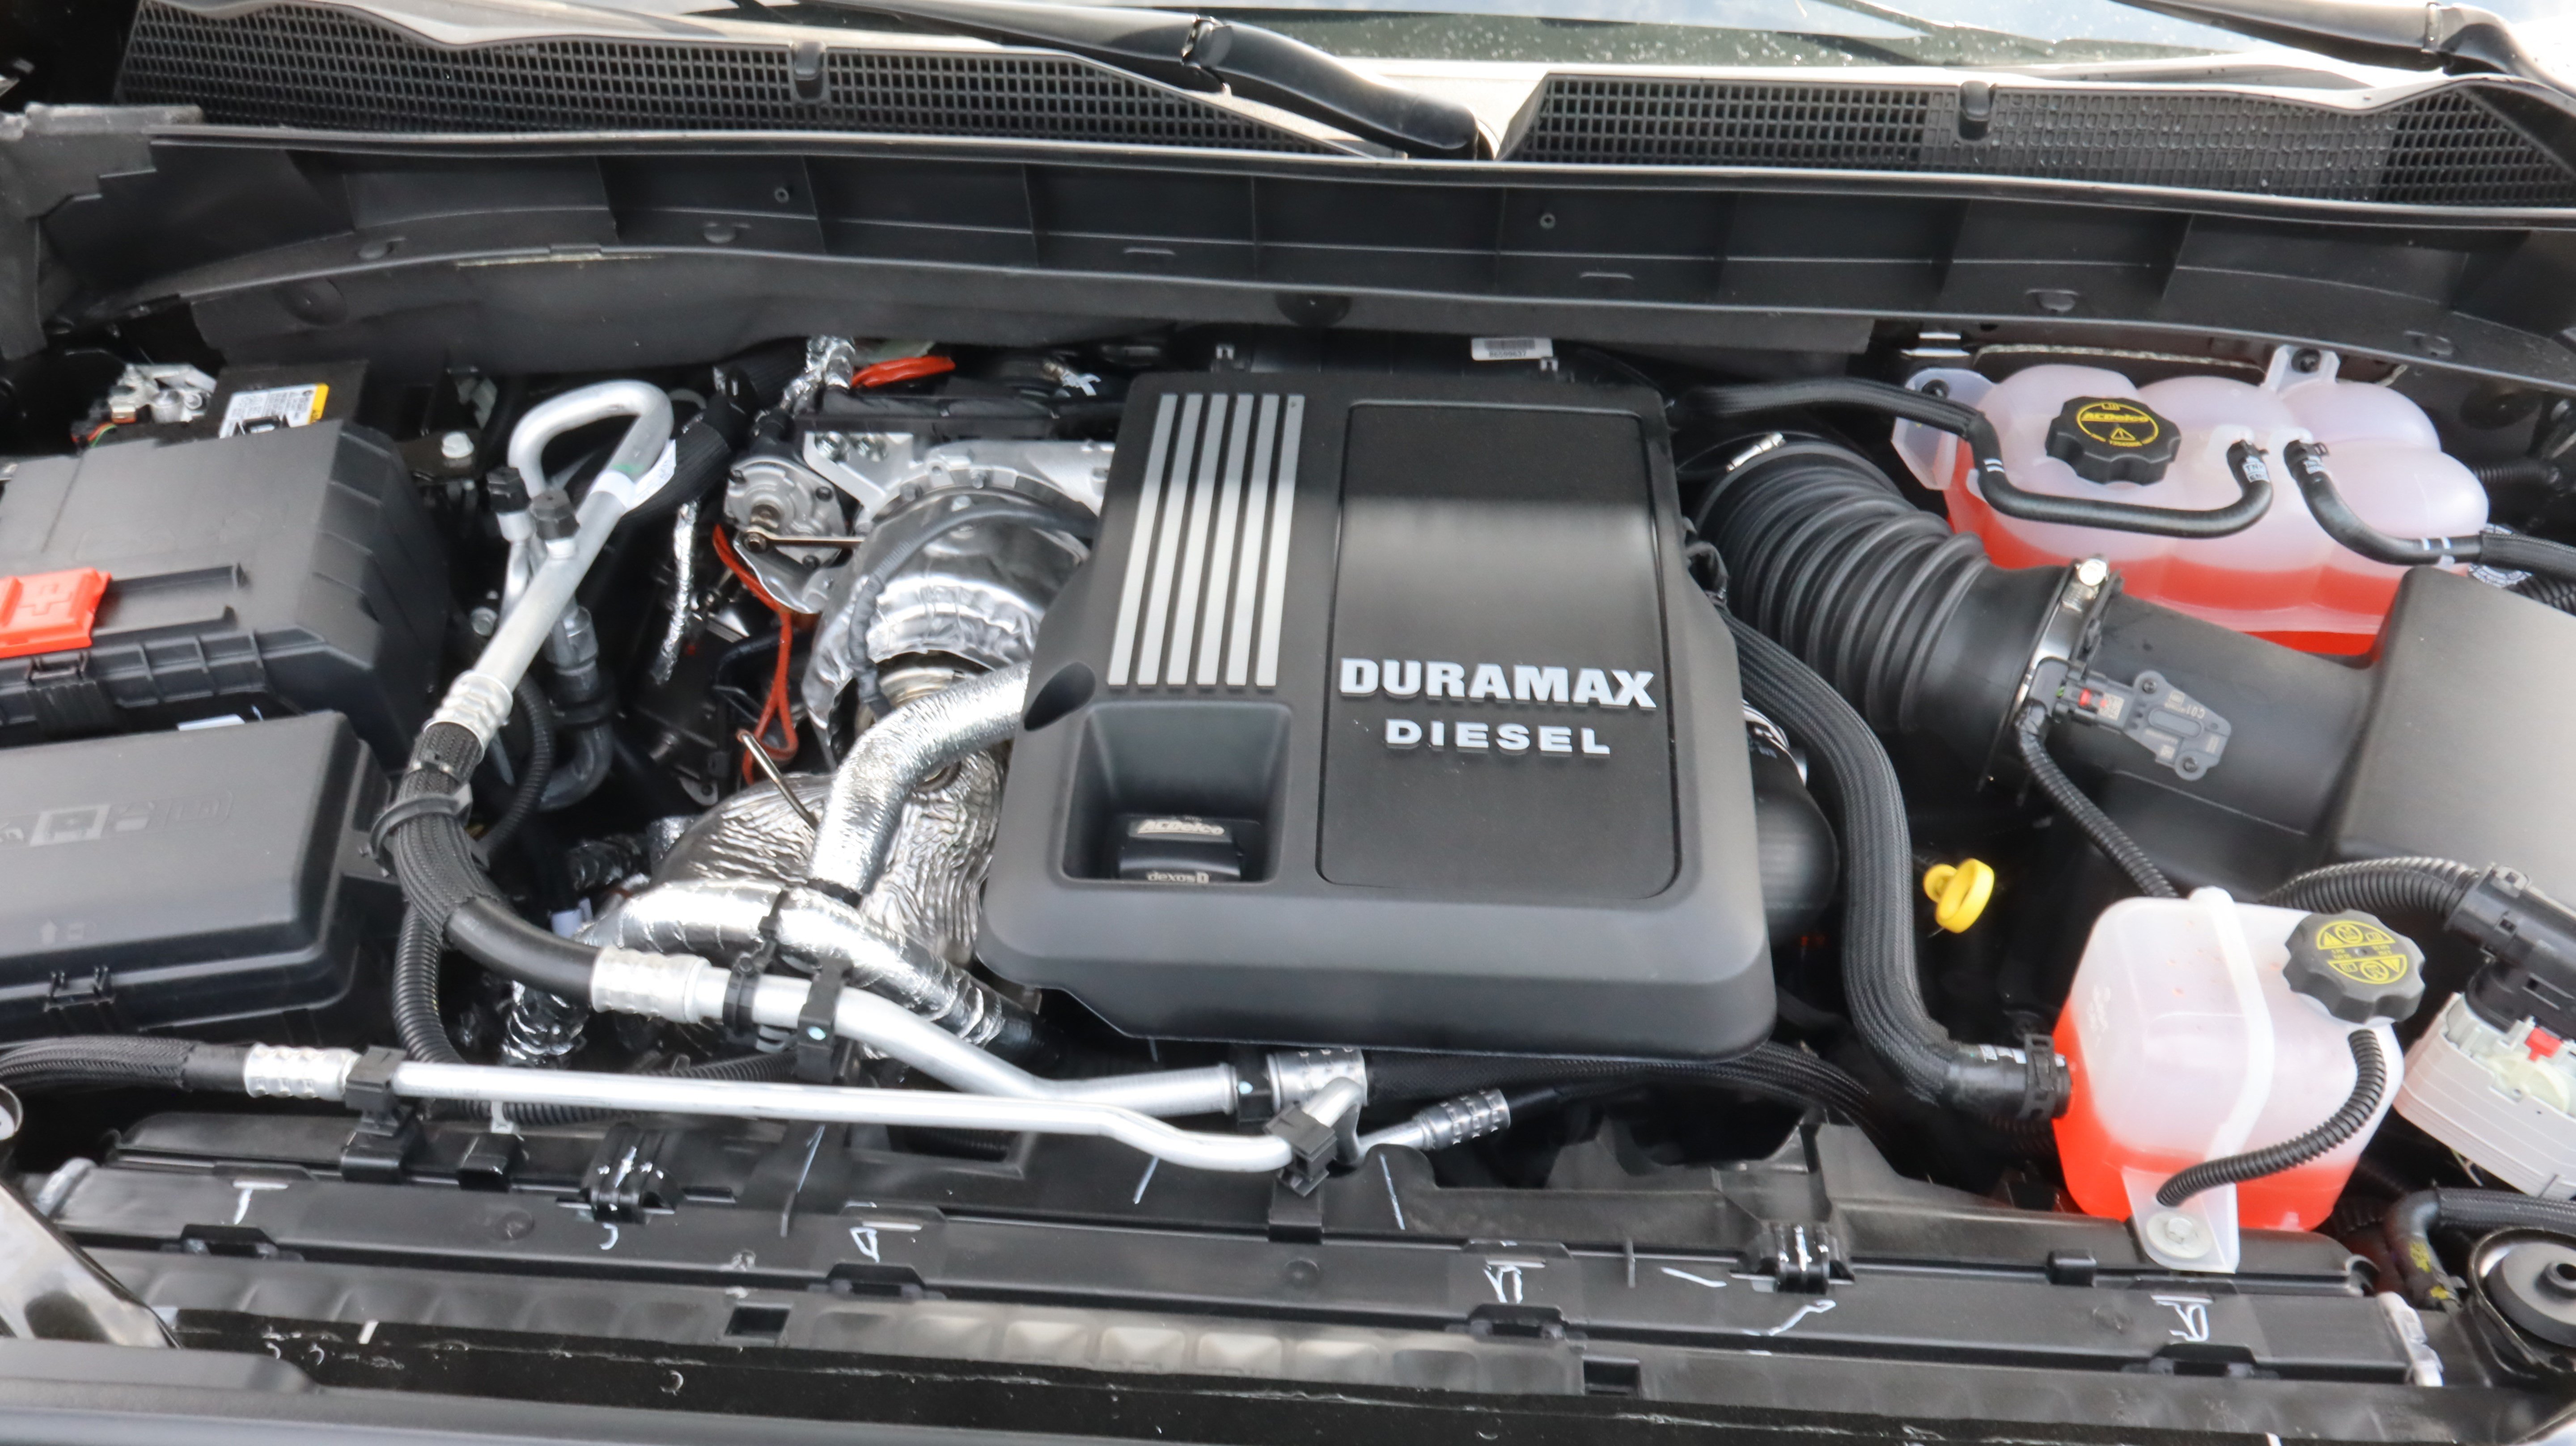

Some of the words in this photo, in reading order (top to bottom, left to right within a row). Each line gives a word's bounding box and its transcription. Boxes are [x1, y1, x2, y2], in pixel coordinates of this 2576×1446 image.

[2081, 412, 2150, 423] ACDelco
[1340, 658, 1657, 708] DURAMAX
[1386, 719, 1610, 755] DIESEL
[1137, 819, 1224, 835] ACDelco
